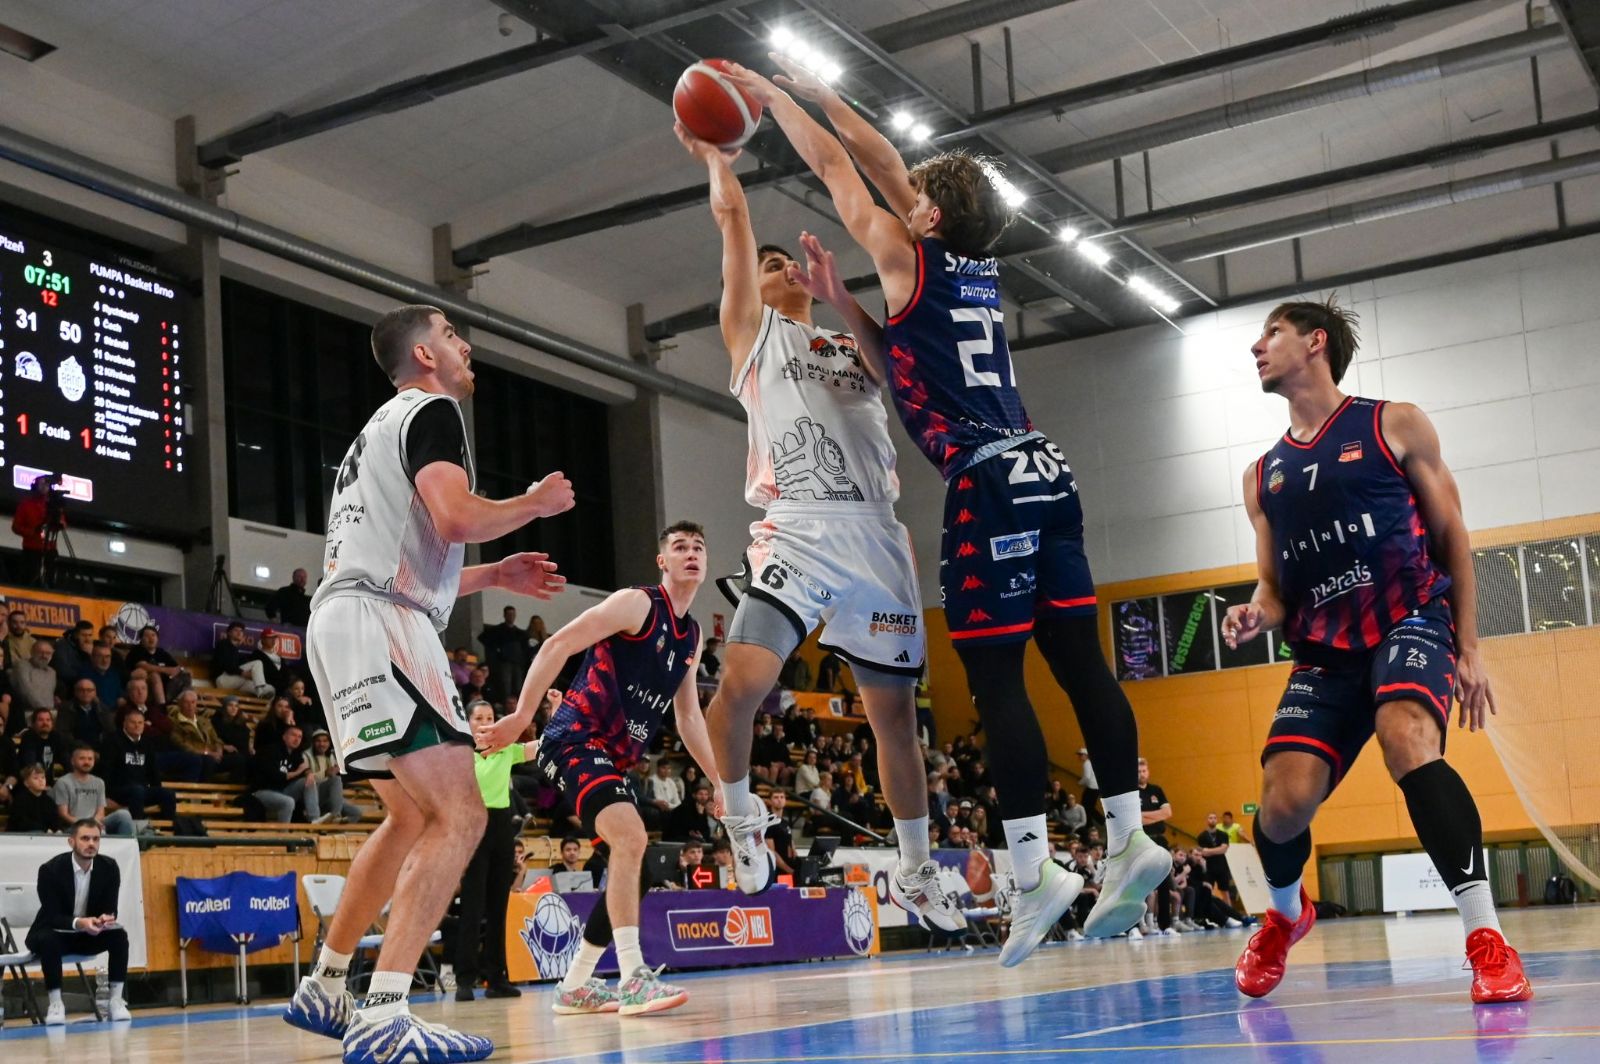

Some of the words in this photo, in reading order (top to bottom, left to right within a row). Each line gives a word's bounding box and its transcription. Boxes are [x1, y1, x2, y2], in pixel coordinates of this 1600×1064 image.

[43, 250, 53, 267] 3
[24, 264, 70, 294] 07:51
[90, 262, 123, 284] PUMPA
[124, 273, 153, 293] Basket
[153, 282, 175, 299] Brno
[41, 289, 58, 307] 12
[960, 285, 996, 300] pumpa
[93, 301, 100, 311] 4
[16, 308, 37, 332] 31
[60, 320, 81, 343] 50
[93, 348, 103, 360] 11
[94, 332, 101, 343] 7
[173, 355, 180, 364] 7
[93, 364, 104, 376] 12
[807, 363, 830, 376] BALI
[832, 369, 864, 385] MANIA
[94, 412, 105, 424] 22
[176, 431, 182, 441] 7
[174, 416, 182, 427] 11
[17, 413, 28, 435] 1
[39, 421, 71, 441] Fouls
[81, 427, 92, 449] 1
[95, 428, 106, 440] 27
[95, 444, 106, 456] 44
[1302, 463, 1319, 492] 7
[760, 563, 788, 591] 6
[781, 560, 804, 578] WEST
[1310, 559, 1373, 604] marais
[872, 612, 917, 627] BASKET
[281, 637, 297, 654] NBL
[666, 649, 676, 672] 4
[1290, 683, 1313, 692] Vista
[364, 722, 393, 739] Plzeň
[185, 897, 231, 914] molten
[249, 895, 290, 912] molten
[676, 921, 721, 940] maxa
[749, 914, 769, 939] NBL
